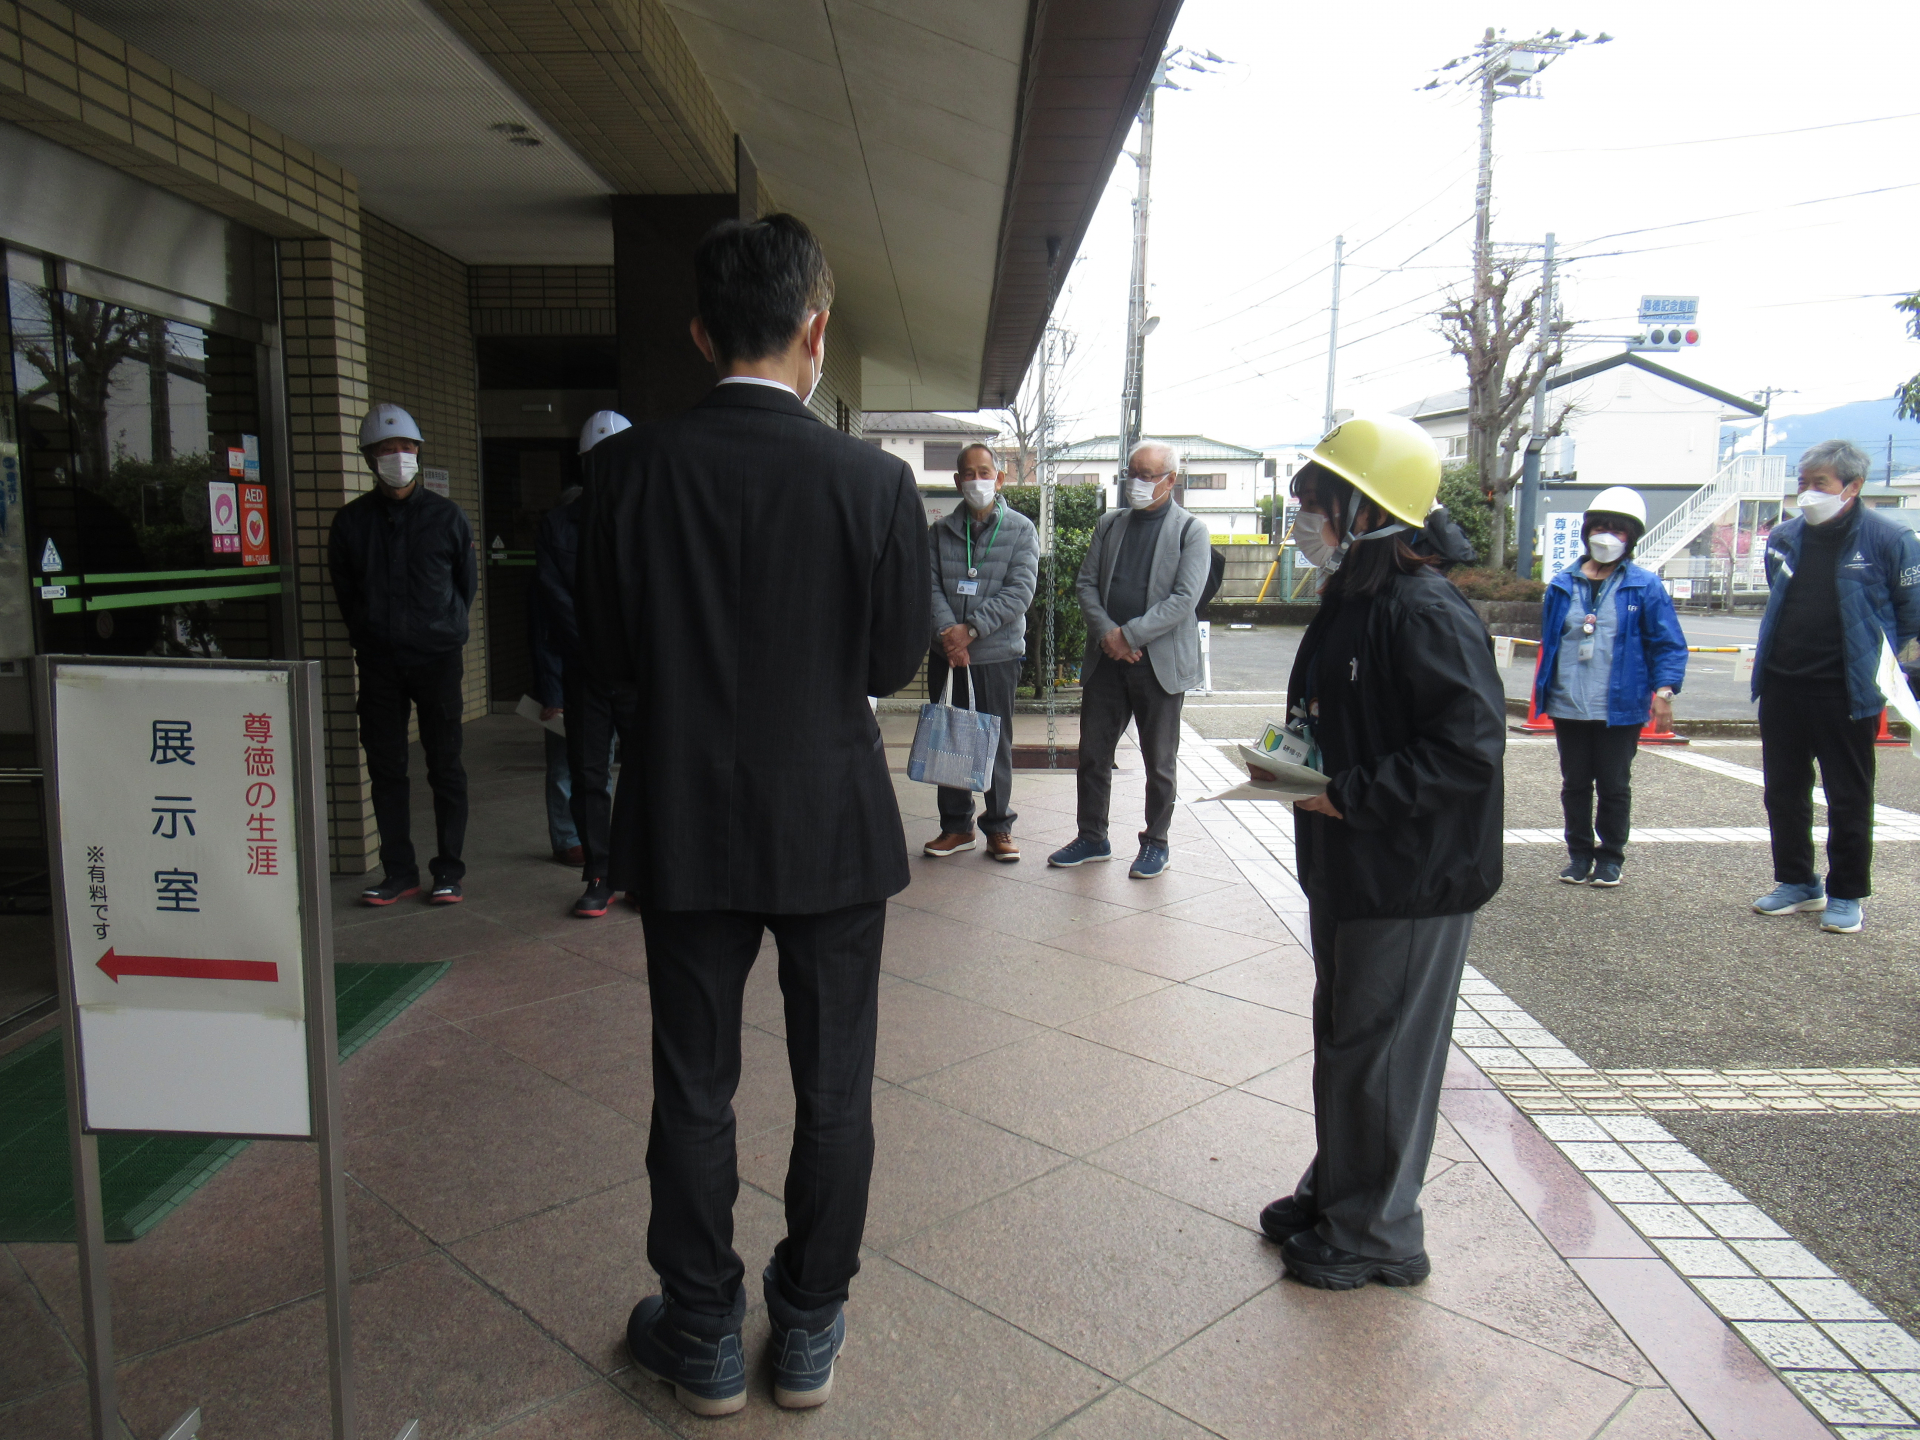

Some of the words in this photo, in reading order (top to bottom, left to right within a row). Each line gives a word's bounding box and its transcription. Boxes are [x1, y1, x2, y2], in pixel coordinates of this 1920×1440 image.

[244, 488, 263, 502] AED
[1569, 518, 1581, 559] 小田原市
[1283, 744, 1303, 758] 研修中
[243, 712, 279, 876] 尊徳の生涯
[150, 719, 201, 913] 展示室
